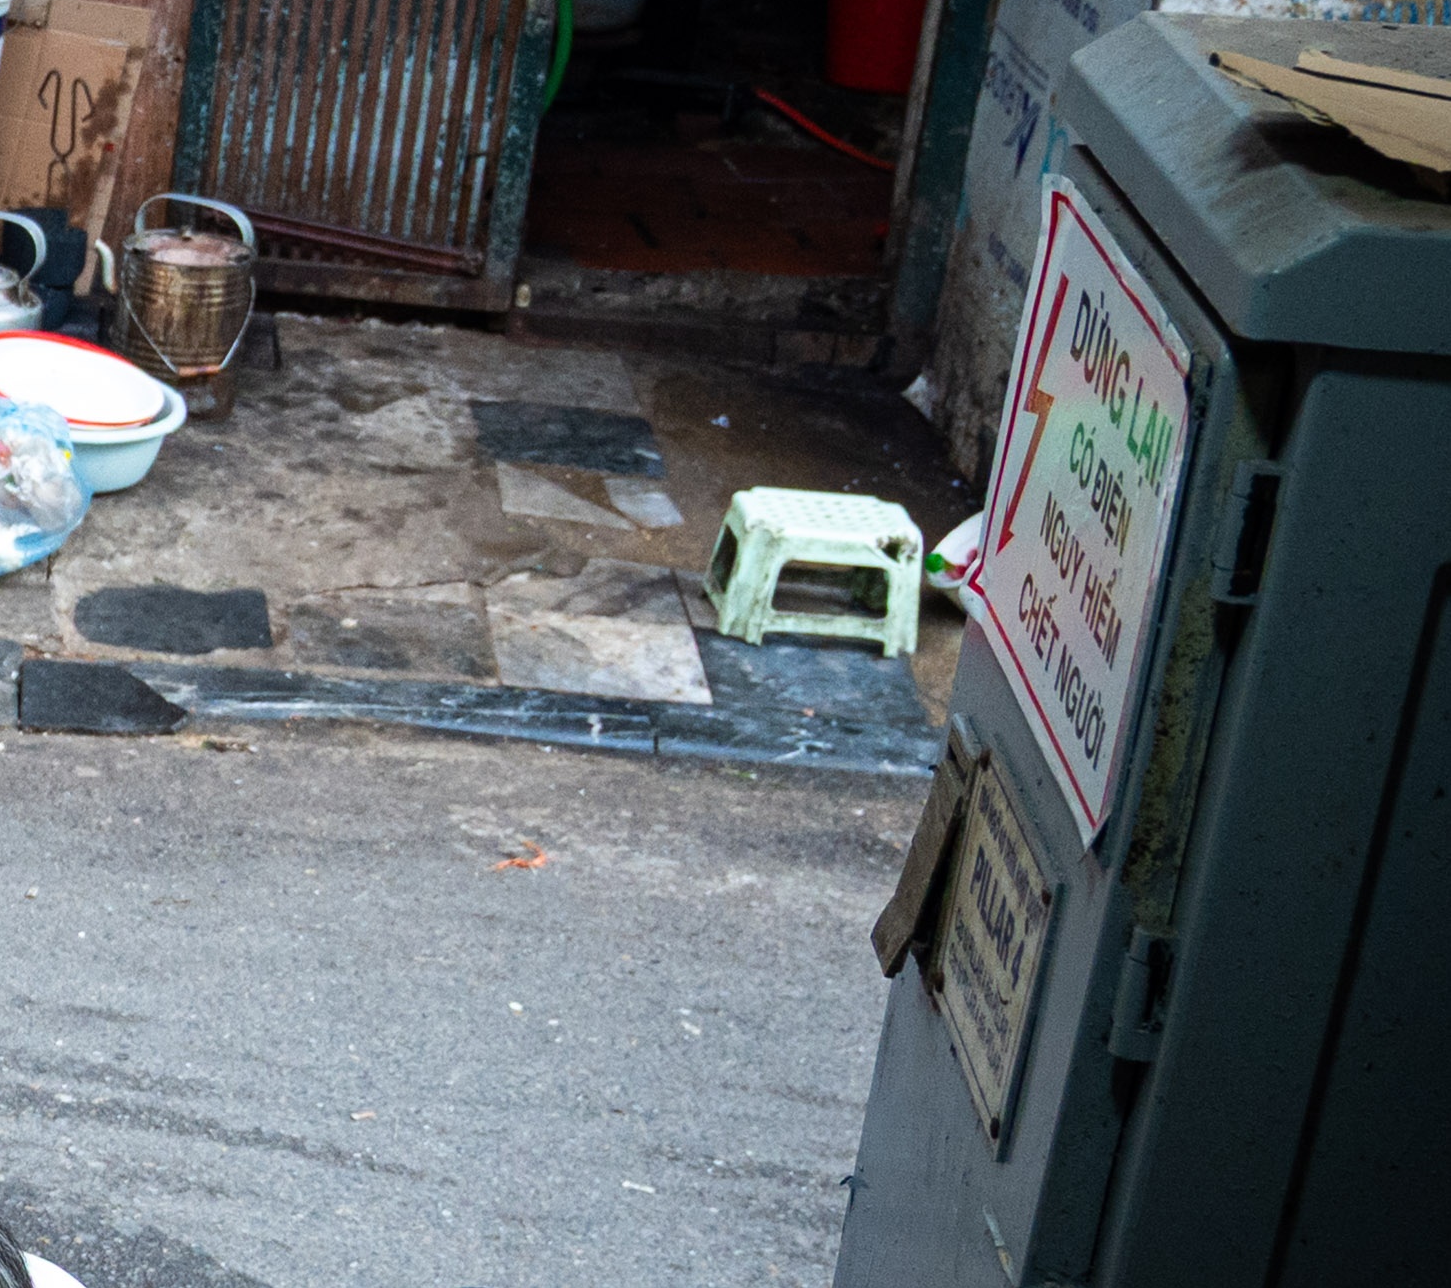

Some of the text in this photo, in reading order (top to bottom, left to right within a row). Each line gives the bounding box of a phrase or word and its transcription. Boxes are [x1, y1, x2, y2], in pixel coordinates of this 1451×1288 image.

[1069, 289, 1132, 425] DỪNG
[1069, 421, 1134, 558] CÓ ĐIỆN
[1017, 572, 1061, 676] CHẾT
[1039, 490, 1123, 671] NGUY HIỂM
[969, 844, 1017, 972] PILLAR
